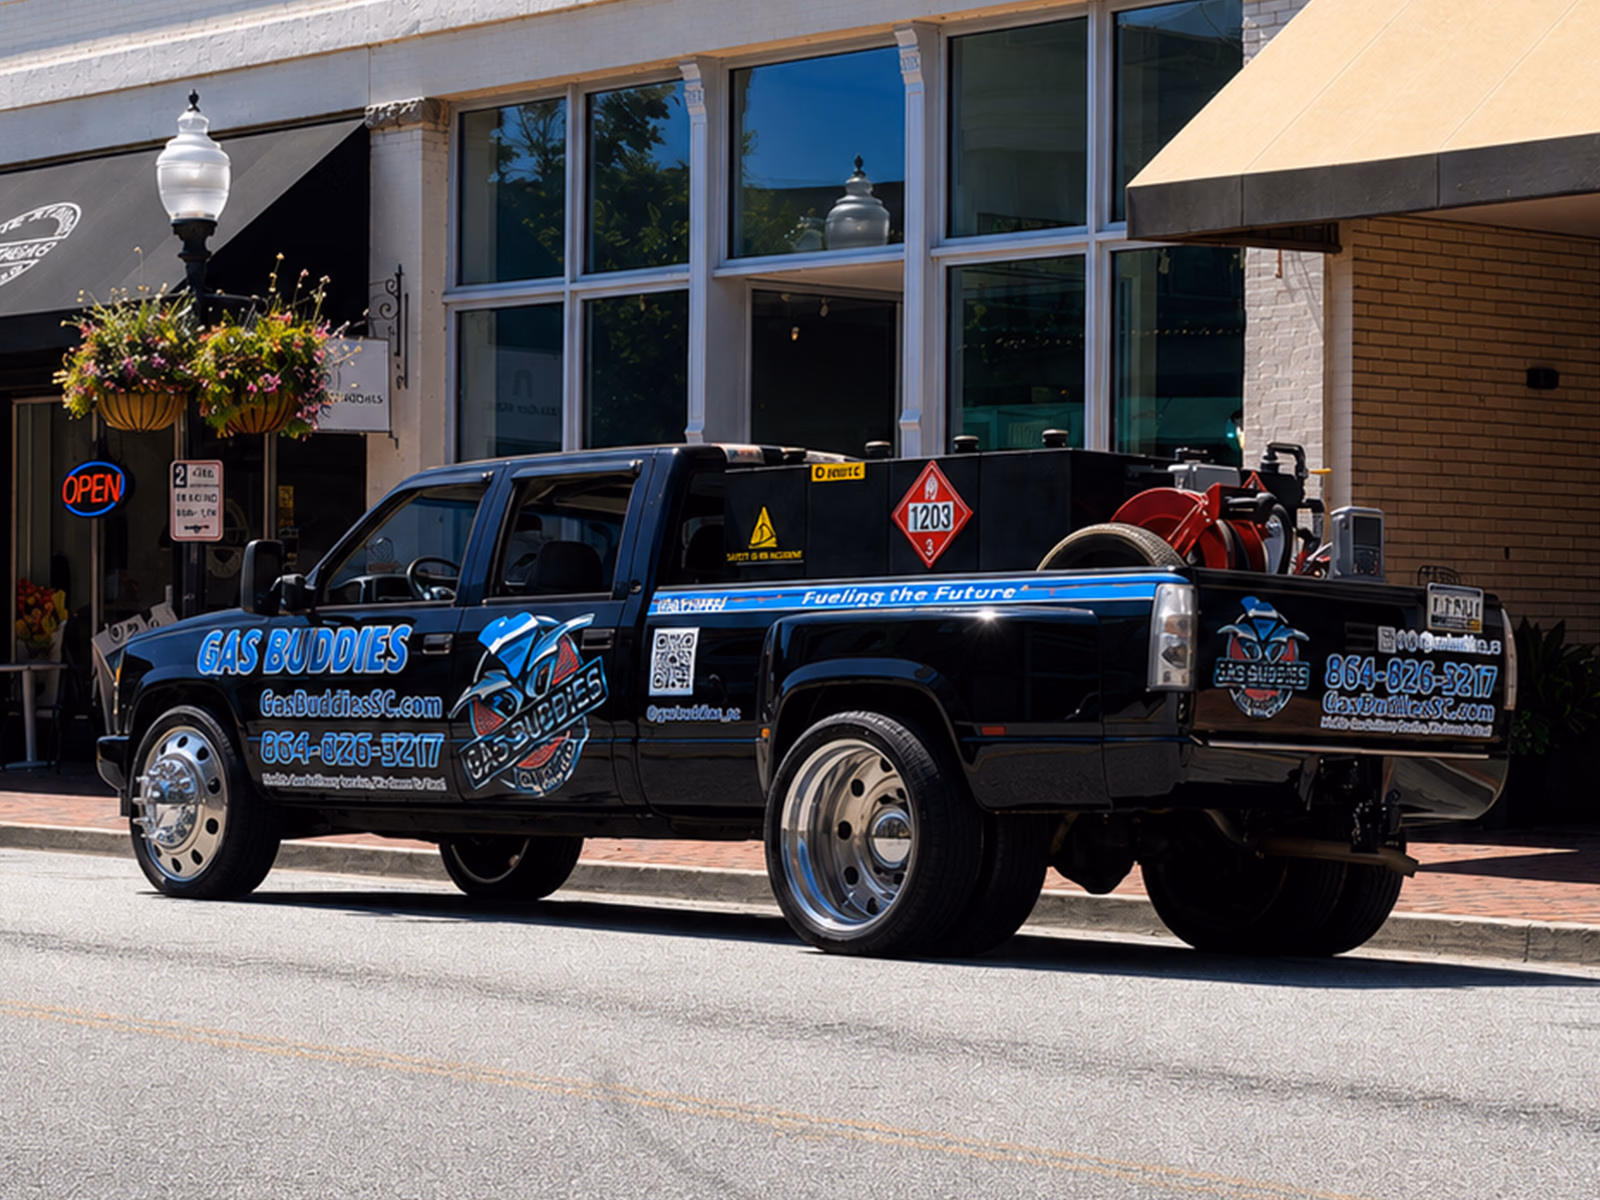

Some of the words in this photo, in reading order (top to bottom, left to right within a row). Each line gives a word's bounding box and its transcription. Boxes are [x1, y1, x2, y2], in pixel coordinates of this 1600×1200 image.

[62, 473, 121, 504] OPEN
[175, 465, 185, 486] 2
[911, 504, 951, 530] 1203
[925, 538, 934, 556] 3
[802, 588, 884, 608] Fueling
[890, 586, 926, 603] the
[933, 585, 1016, 602] Future
[197, 629, 263, 675] GAS
[263, 624, 413, 675] BUDDIES
[260, 688, 443, 718] GasBuddiesSC.com
